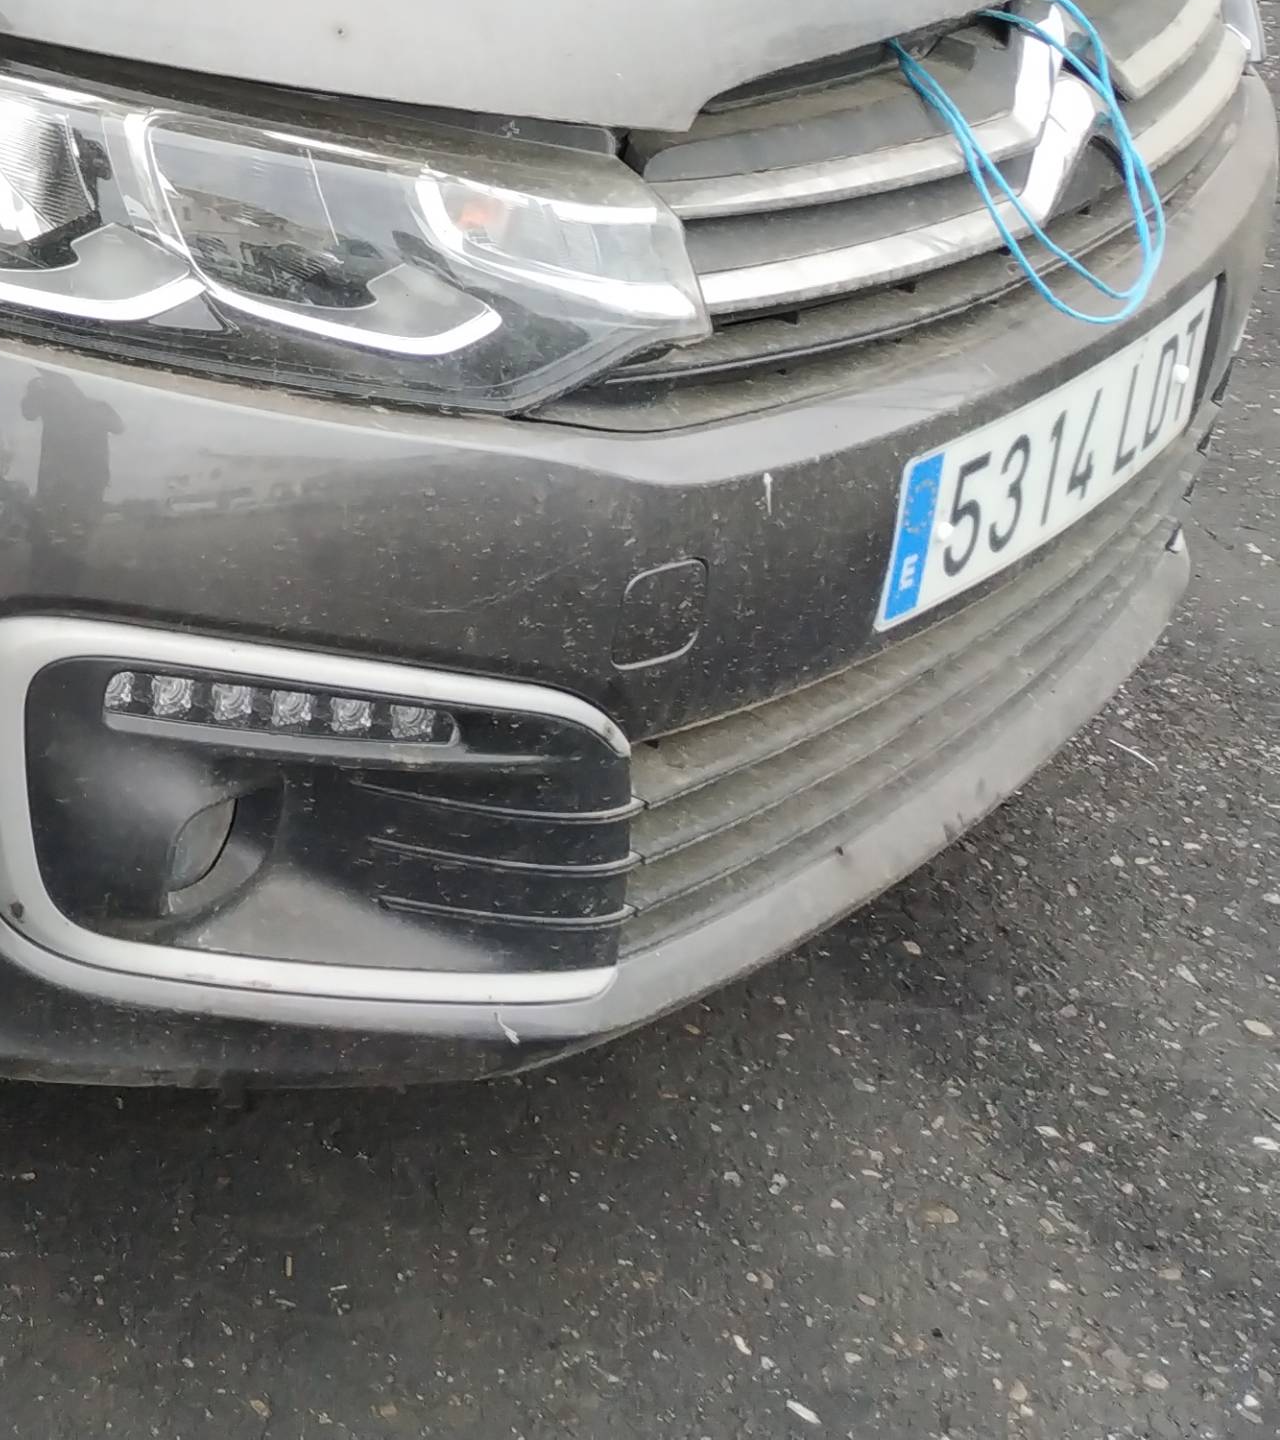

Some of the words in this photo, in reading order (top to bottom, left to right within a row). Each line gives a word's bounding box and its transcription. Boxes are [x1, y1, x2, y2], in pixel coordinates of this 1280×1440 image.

[942, 387, 1104, 578] 5314
[1111, 308, 1207, 476] LDT
[898, 552, 919, 592] E
